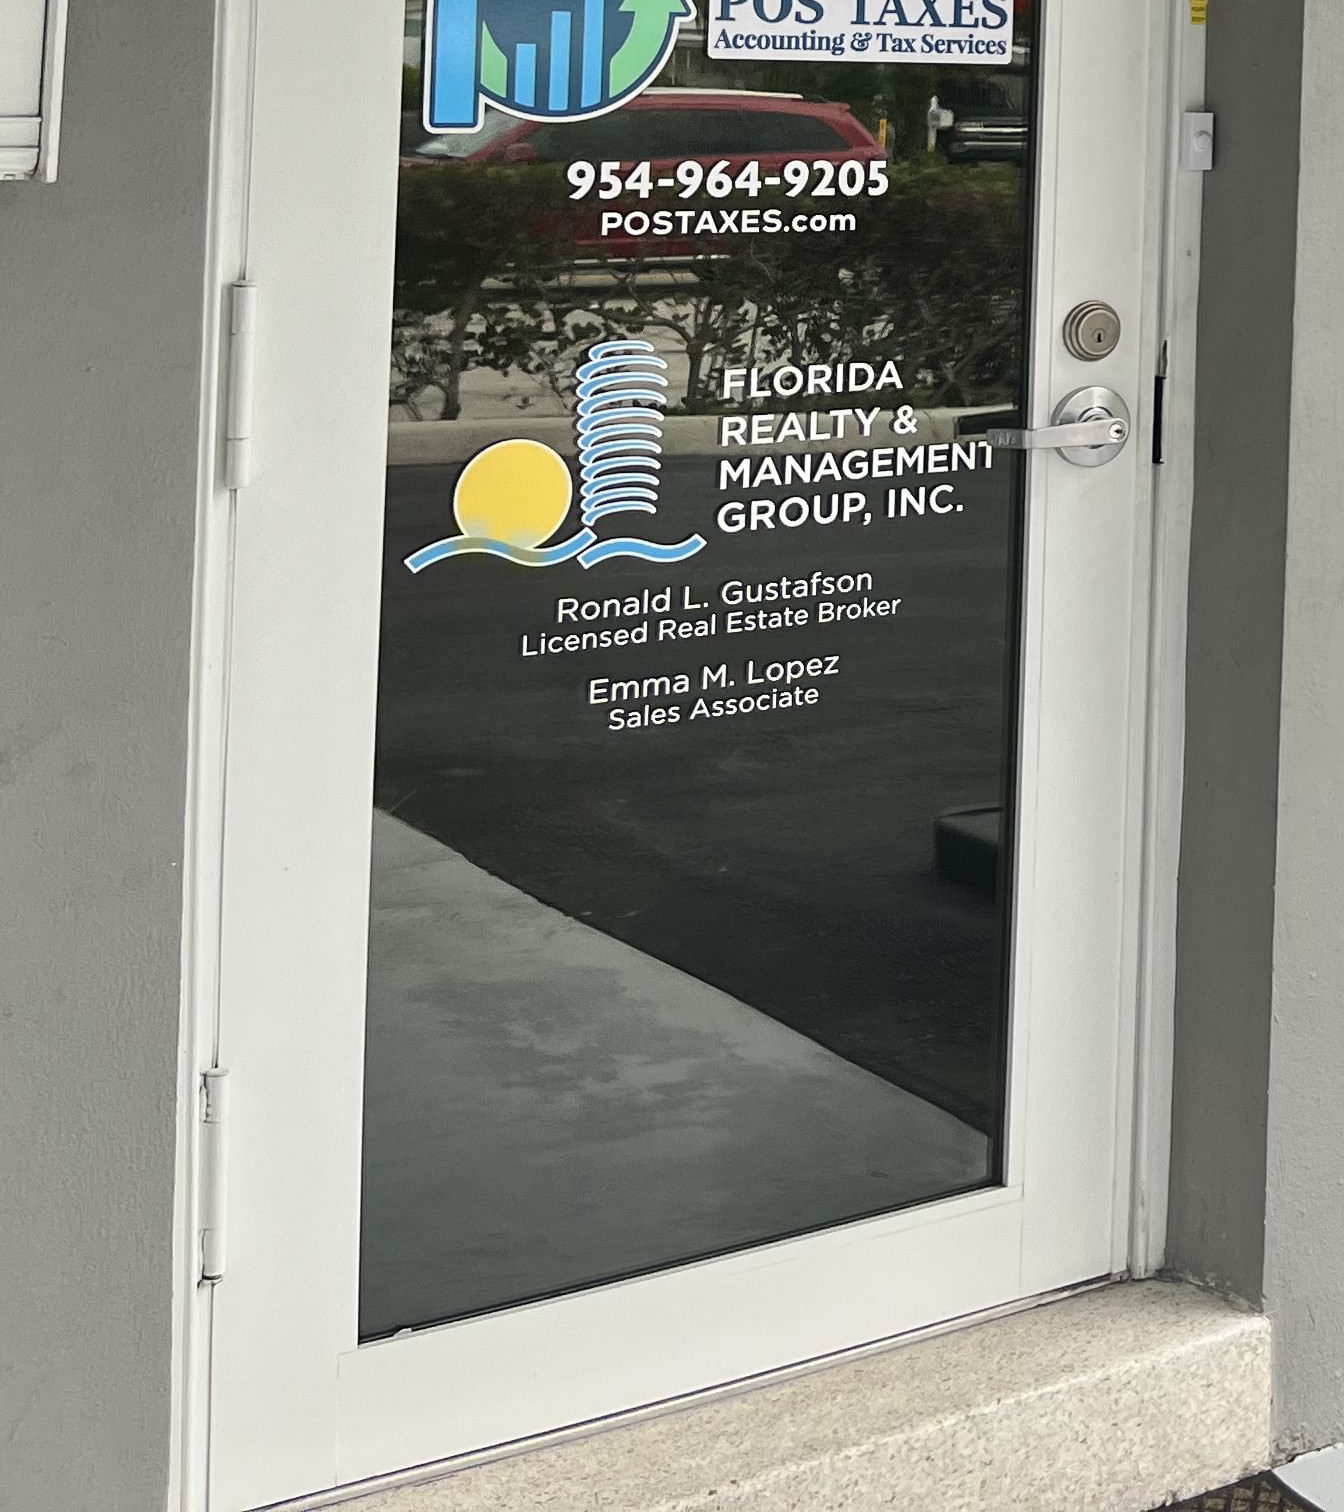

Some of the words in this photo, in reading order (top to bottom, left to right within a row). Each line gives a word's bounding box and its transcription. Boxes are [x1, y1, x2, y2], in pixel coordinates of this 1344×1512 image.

[714, 29, 845, 55] Accounting
[850, 33, 872, 51] &
[877, 33, 916, 54] Tax
[920, 34, 1007, 57] Services
[566, 160, 889, 200] 954-964-9205
[601, 208, 857, 236] POSTAXES.com
[723, 360, 903, 400] FLORIDA
[720, 406, 877, 448] REALTY
[893, 404, 919, 434] &
[718, 440, 993, 491] MANAGEMENT
[716, 493, 873, 533] GROUP,
[887, 483, 965, 519] INC.
[556, 587, 672, 624] Ronald
[682, 583, 709, 611] L.
[720, 567, 874, 607] Gustafson
[521, 623, 648, 657] Licensed
[658, 612, 717, 642] Real
[726, 604, 809, 636] Estate
[817, 595, 902, 626] Broker
[588, 672, 691, 706] Emma
[701, 665, 736, 691] M.
[747, 653, 840, 690] Lopez
[607, 704, 682, 732] Sales
[689, 684, 820, 722] Associate
